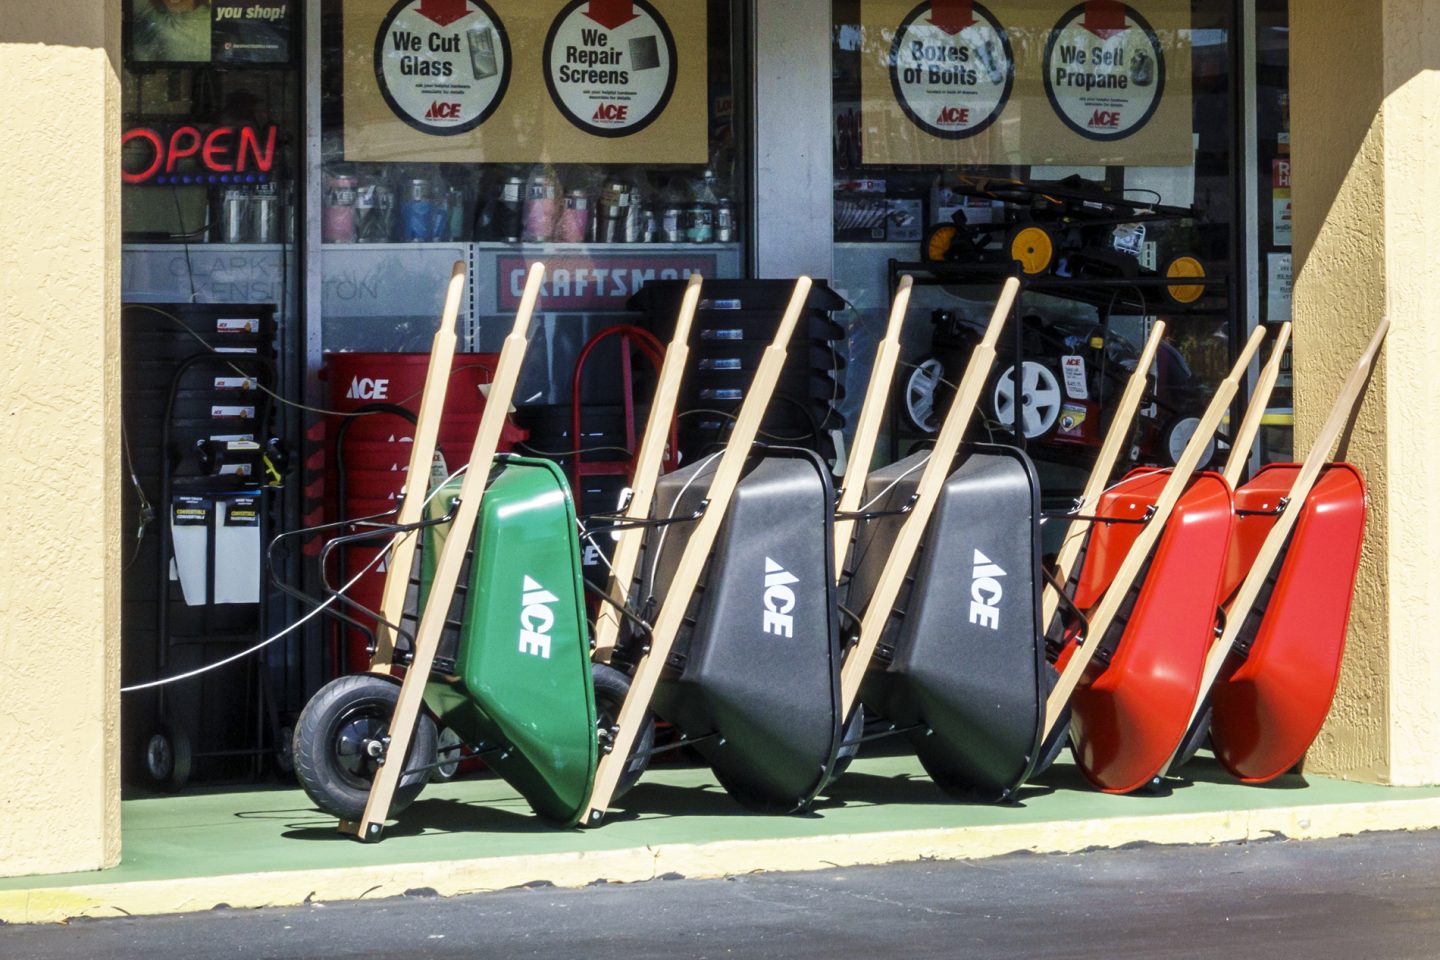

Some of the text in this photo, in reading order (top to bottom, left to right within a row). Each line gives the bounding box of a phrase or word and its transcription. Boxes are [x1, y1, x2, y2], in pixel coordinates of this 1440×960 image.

[216, 5, 287, 22] you shop!
[392, 31, 461, 53] We Cut
[581, 28, 608, 47] We
[566, 45, 623, 68] Repair
[911, 40, 969, 62] Boxes
[1060, 45, 1124, 66] We Sell
[400, 55, 453, 77] Glass
[559, 65, 629, 85] Screens
[903, 64, 922, 85] of
[1055, 67, 1128, 92] Propane
[425, 100, 462, 119] ACE
[592, 102, 629, 120] ACE
[936, 106, 970, 123] ACE
[1088, 109, 1121, 127] ACE
[121, 125, 278, 184] OPEN
[346, 375, 389, 400] ACE
[762, 555, 801, 639] ACE
[969, 548, 1008, 630] ACE
[518, 573, 560, 659] ACE
